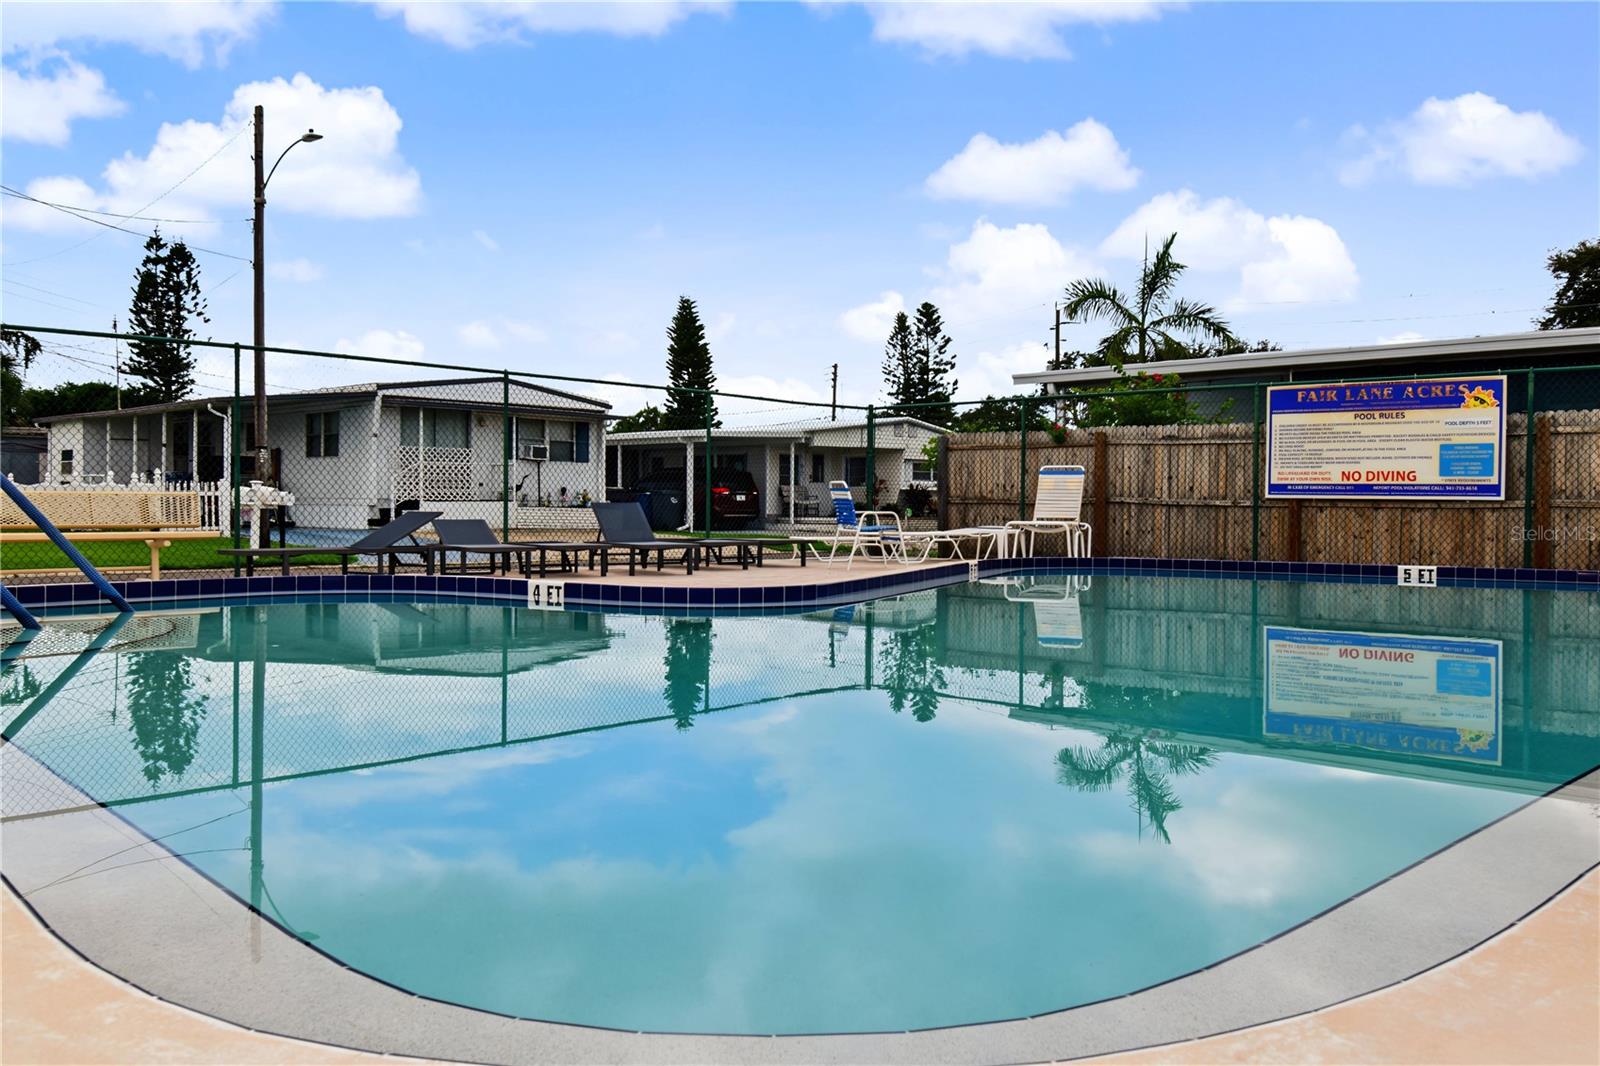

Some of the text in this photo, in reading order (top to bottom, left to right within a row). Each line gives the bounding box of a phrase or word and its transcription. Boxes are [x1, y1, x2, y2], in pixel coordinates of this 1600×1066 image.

[1297, 382, 1471, 403] FAIR LANE ACRES
[1354, 411, 1406, 421] POOL RULES
[1341, 470, 1417, 482] NO DIVING
